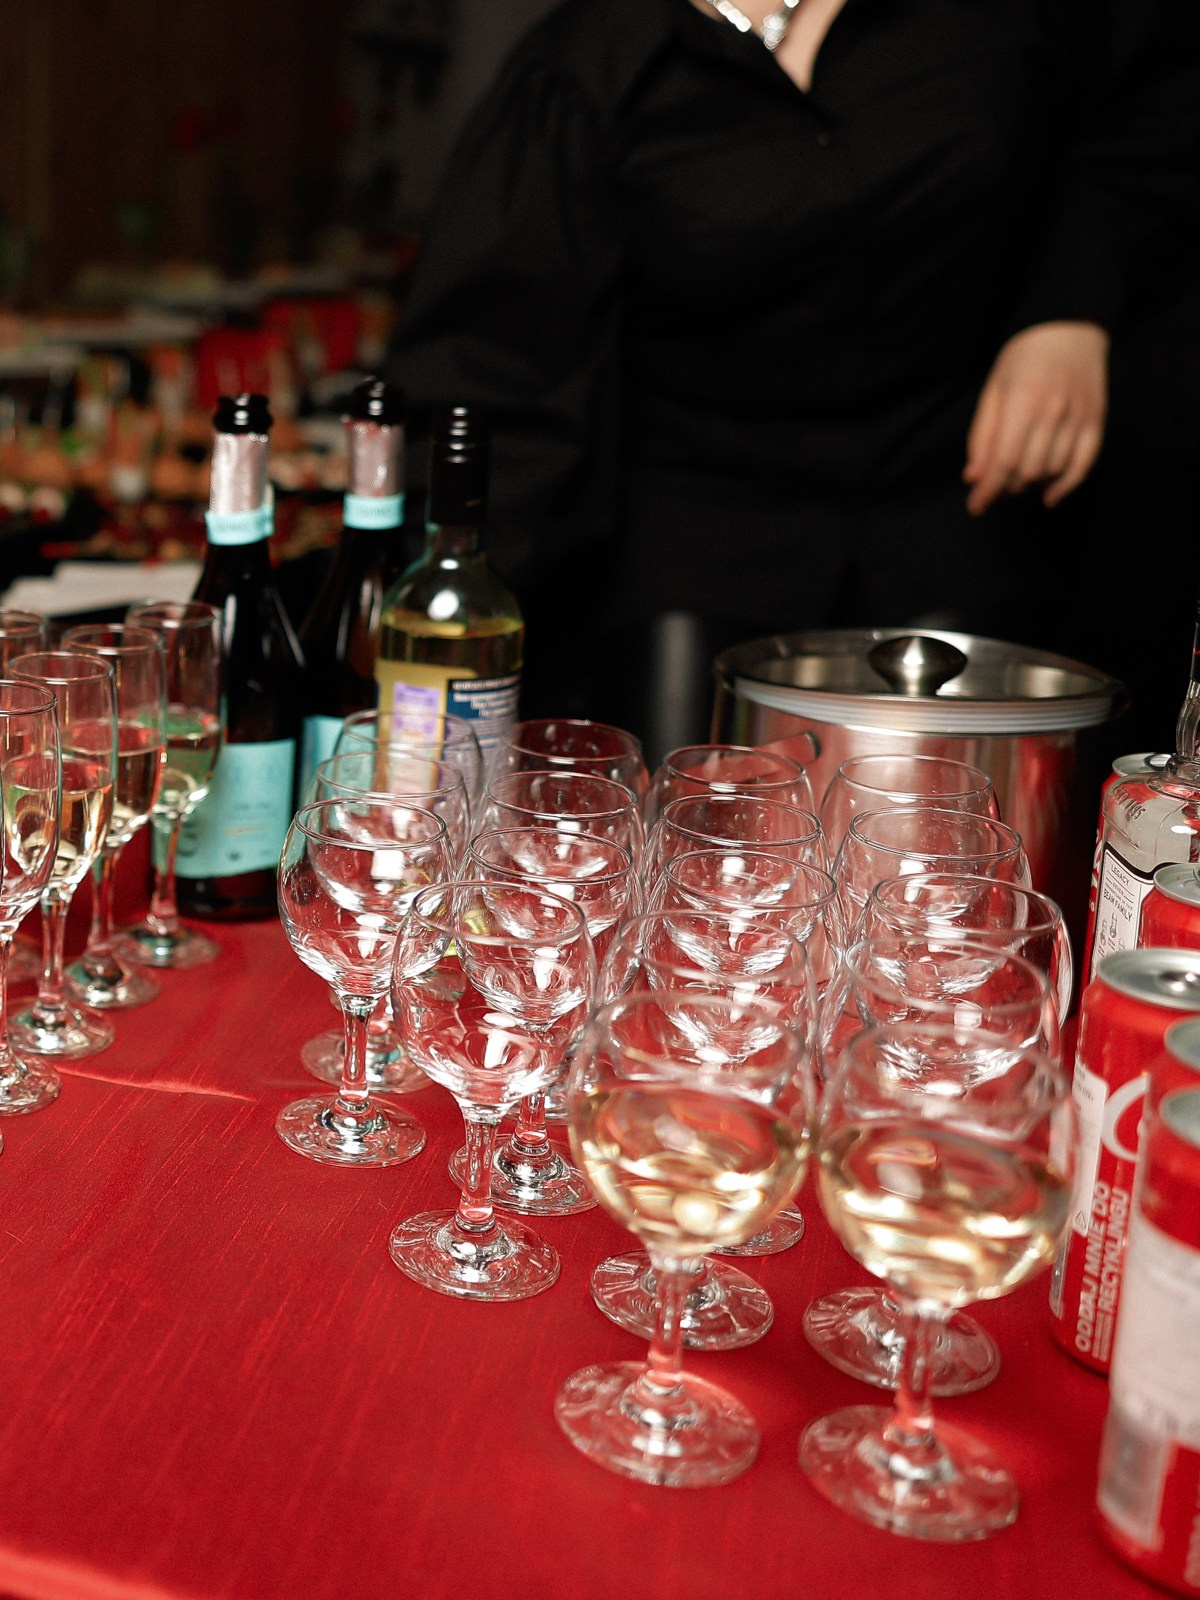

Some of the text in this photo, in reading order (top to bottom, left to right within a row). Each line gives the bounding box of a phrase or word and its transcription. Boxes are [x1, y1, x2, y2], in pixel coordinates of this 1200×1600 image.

[1111, 864, 1130, 886] LEGACY
[1114, 899, 1133, 922] FAMILY
[1075, 1181, 1111, 1352] ODDAJ MNIE DO
[1097, 1186, 1130, 1313] RECYKLINGU
